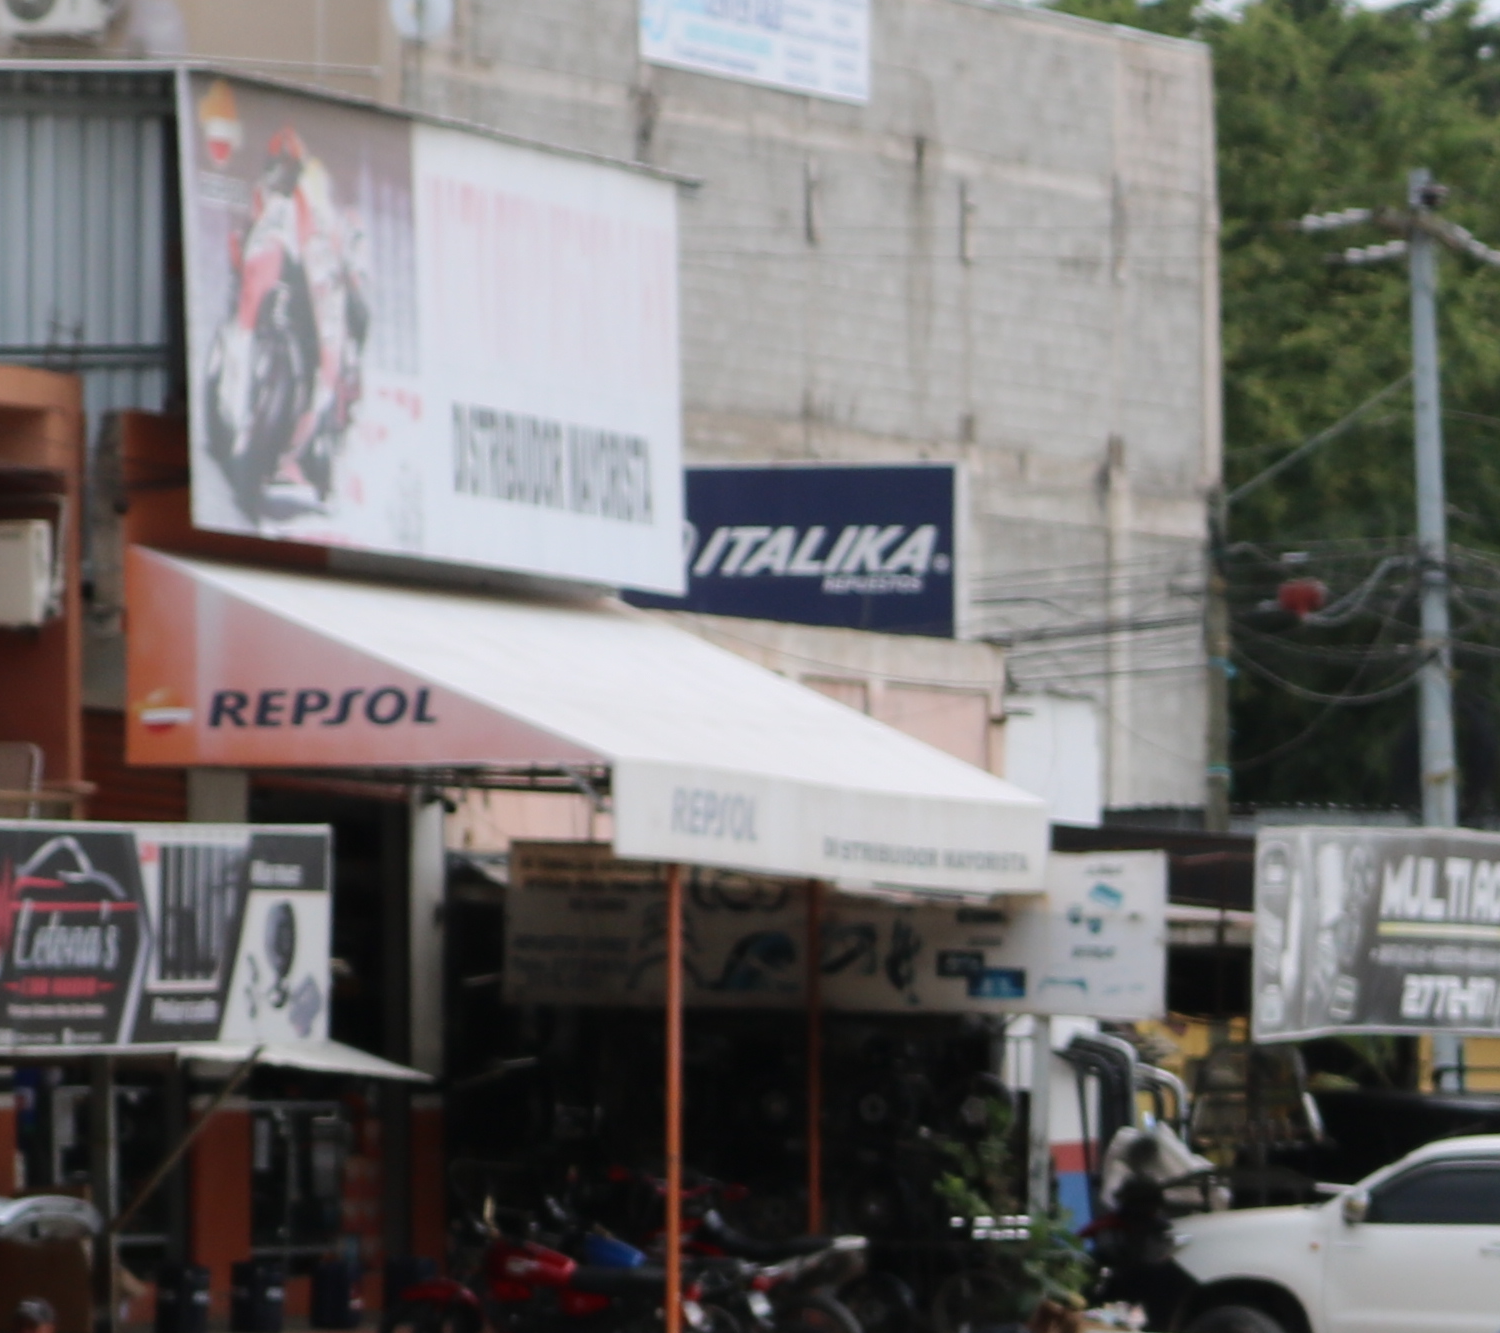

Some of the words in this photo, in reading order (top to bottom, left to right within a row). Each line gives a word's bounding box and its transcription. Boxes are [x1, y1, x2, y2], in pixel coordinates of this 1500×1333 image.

[693, 524, 938, 577] ITALIKA
[822, 575, 923, 594] REPUESTOS
[208, 687, 437, 727] REPSOL
[671, 787, 758, 841] REPSOL
